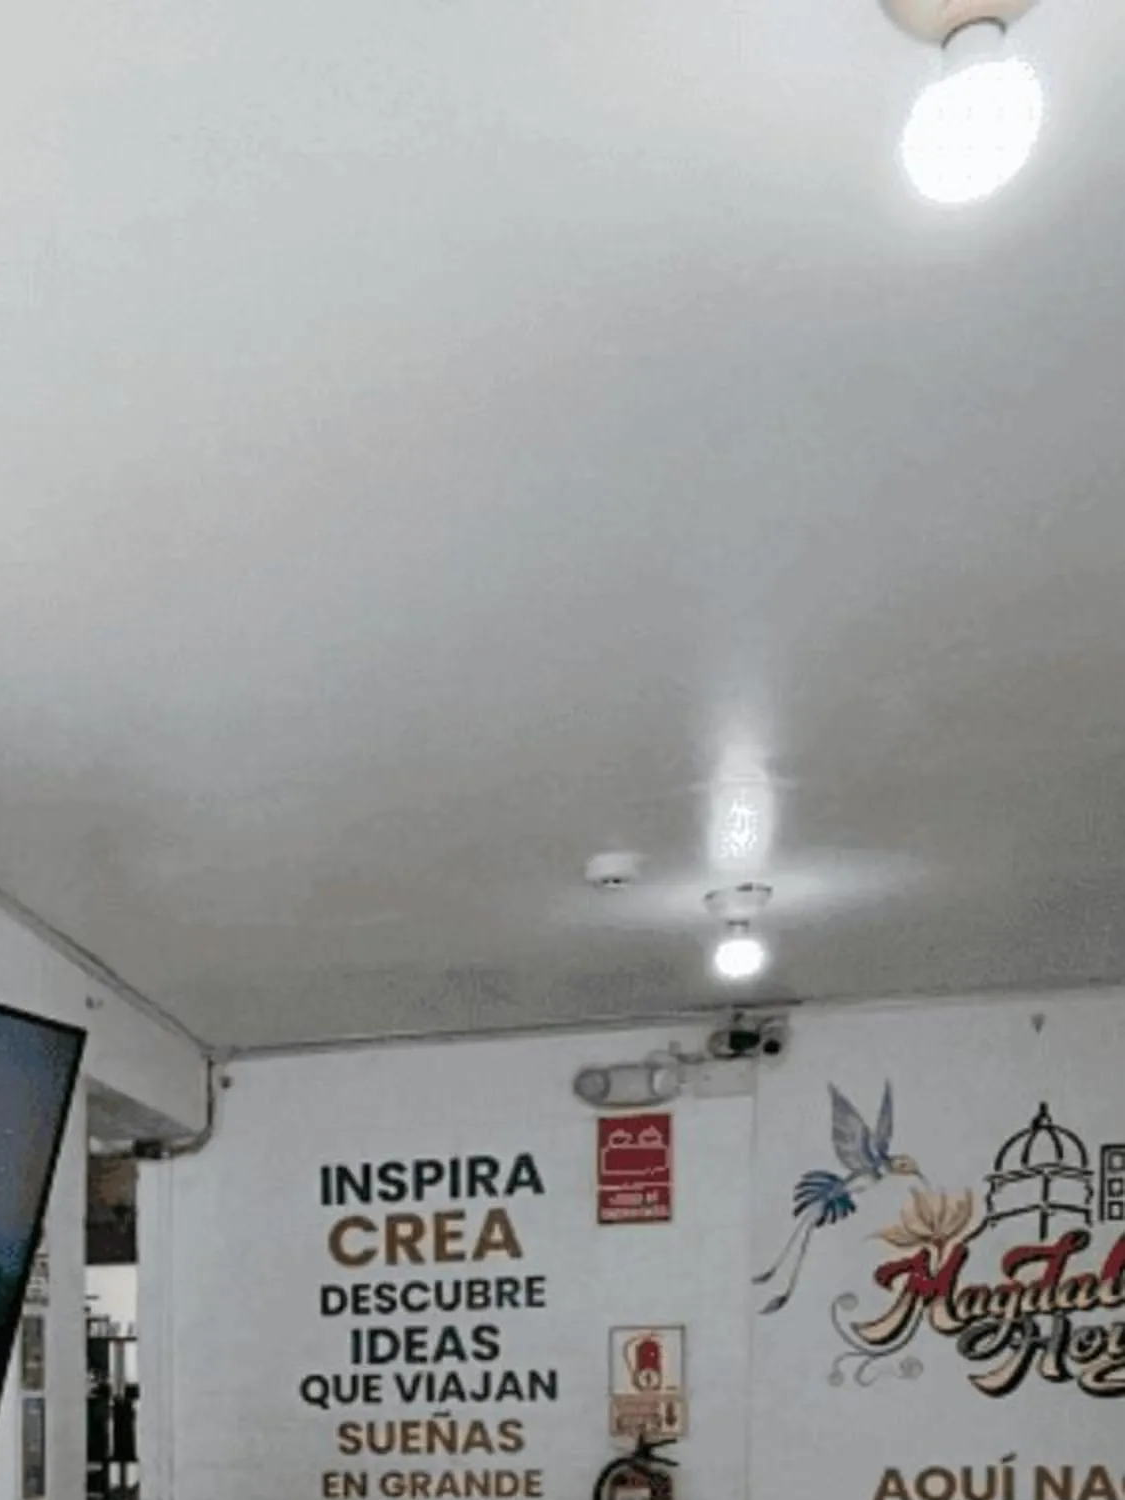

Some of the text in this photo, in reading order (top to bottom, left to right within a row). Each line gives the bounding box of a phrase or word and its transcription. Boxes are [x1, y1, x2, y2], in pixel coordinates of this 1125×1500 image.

[320, 1152, 545, 1206] INSPIRA
[327, 1207, 524, 1267] CREA
[320, 1275, 546, 1317] DESCUBRE
[350, 1324, 501, 1365] IDEAS
[299, 1369, 559, 1410] QUE VIAJAN
[336, 1411, 525, 1456] SUEÑAS
[321, 1469, 544, 1500] EN GRANDE
